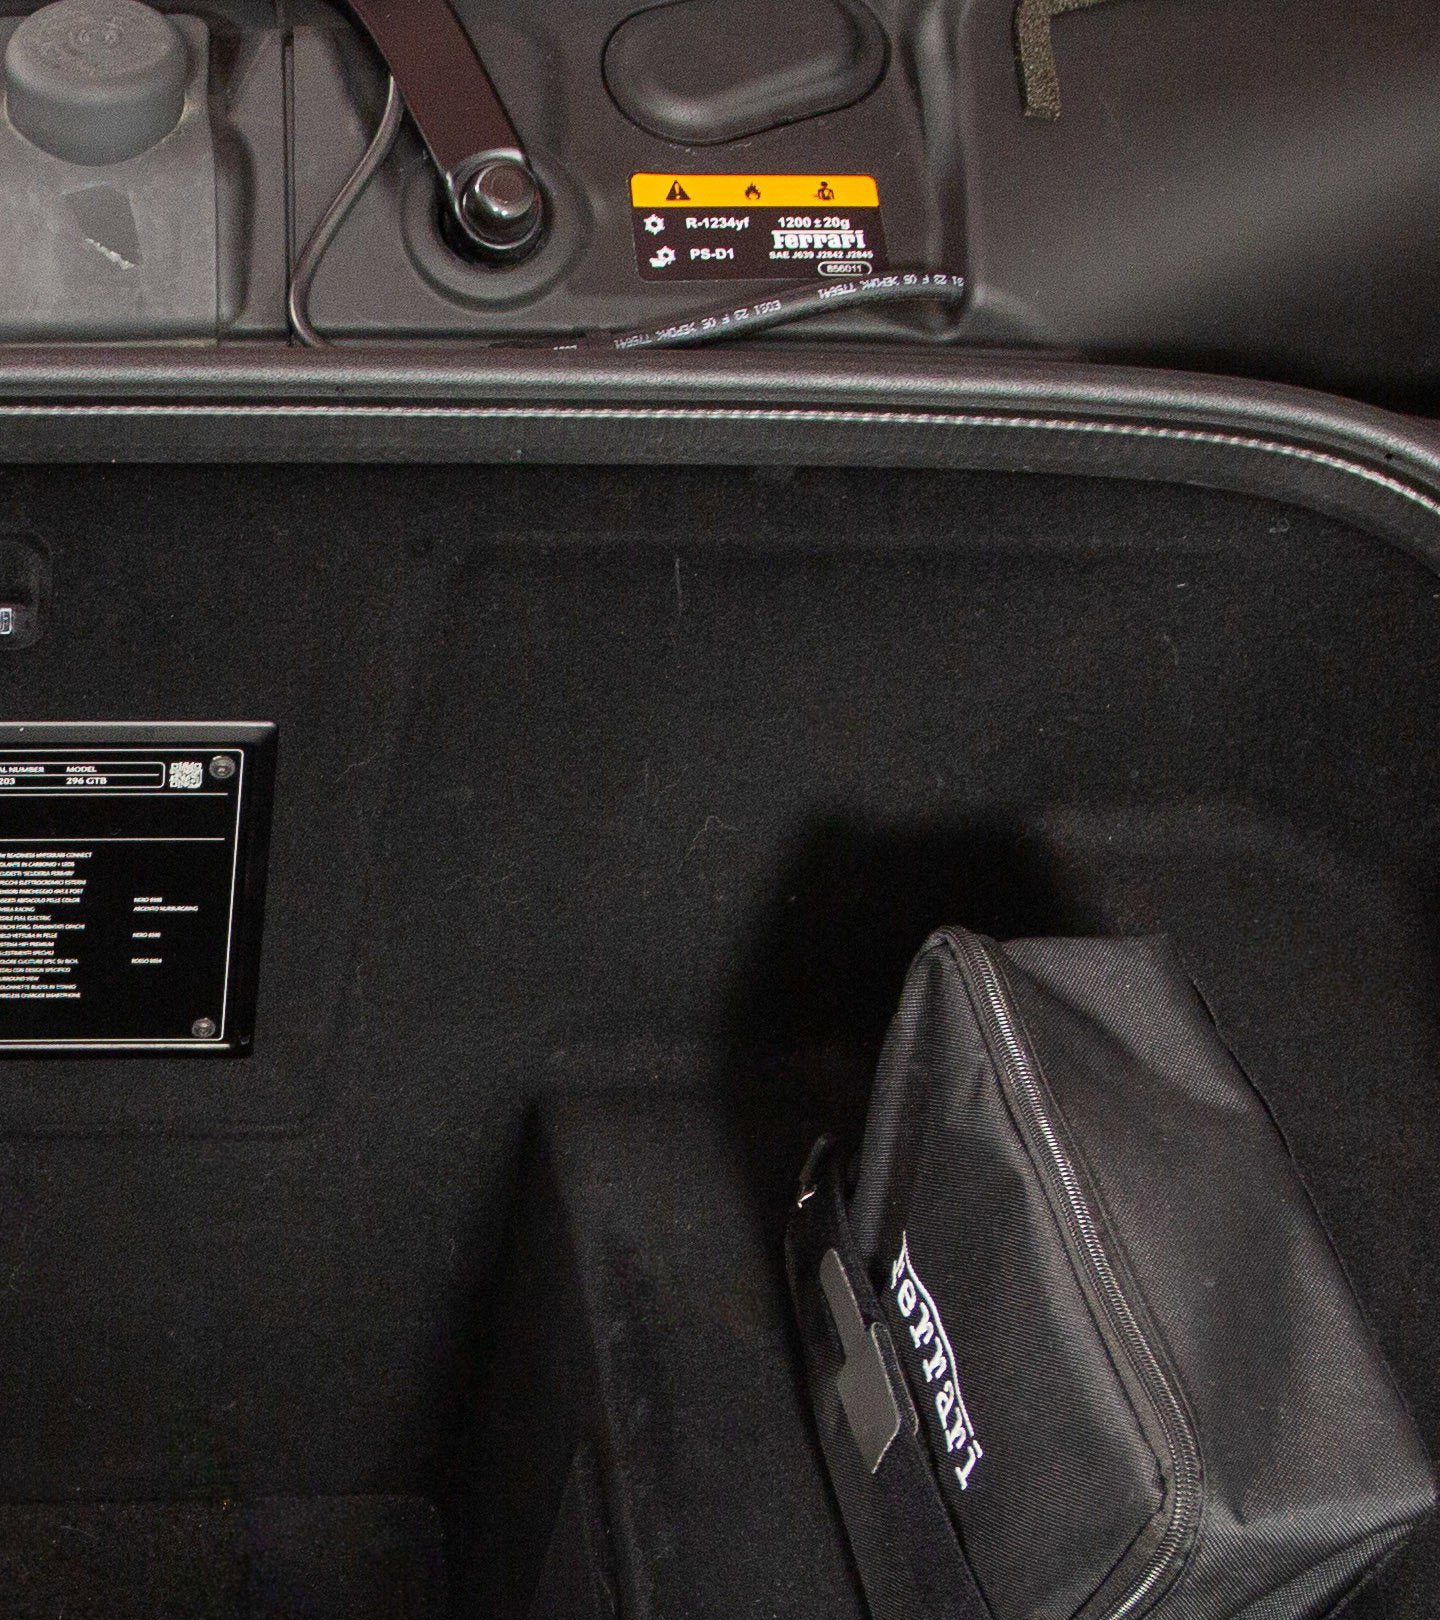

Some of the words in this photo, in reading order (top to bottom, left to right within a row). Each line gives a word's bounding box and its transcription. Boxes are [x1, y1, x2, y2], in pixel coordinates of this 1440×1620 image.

[685, 216, 750, 231] R-1234yf
[777, 216, 812, 229] 1200
[770, 229, 867, 250] Ferrari
[689, 247, 735, 261] PS-D1
[769, 250, 790, 259] SAE
[792, 250, 815, 259] J639
[65, 777, 85, 785] 296
[85, 777, 108, 785] GTB
[890, 1230, 983, 1491] Ferrari
